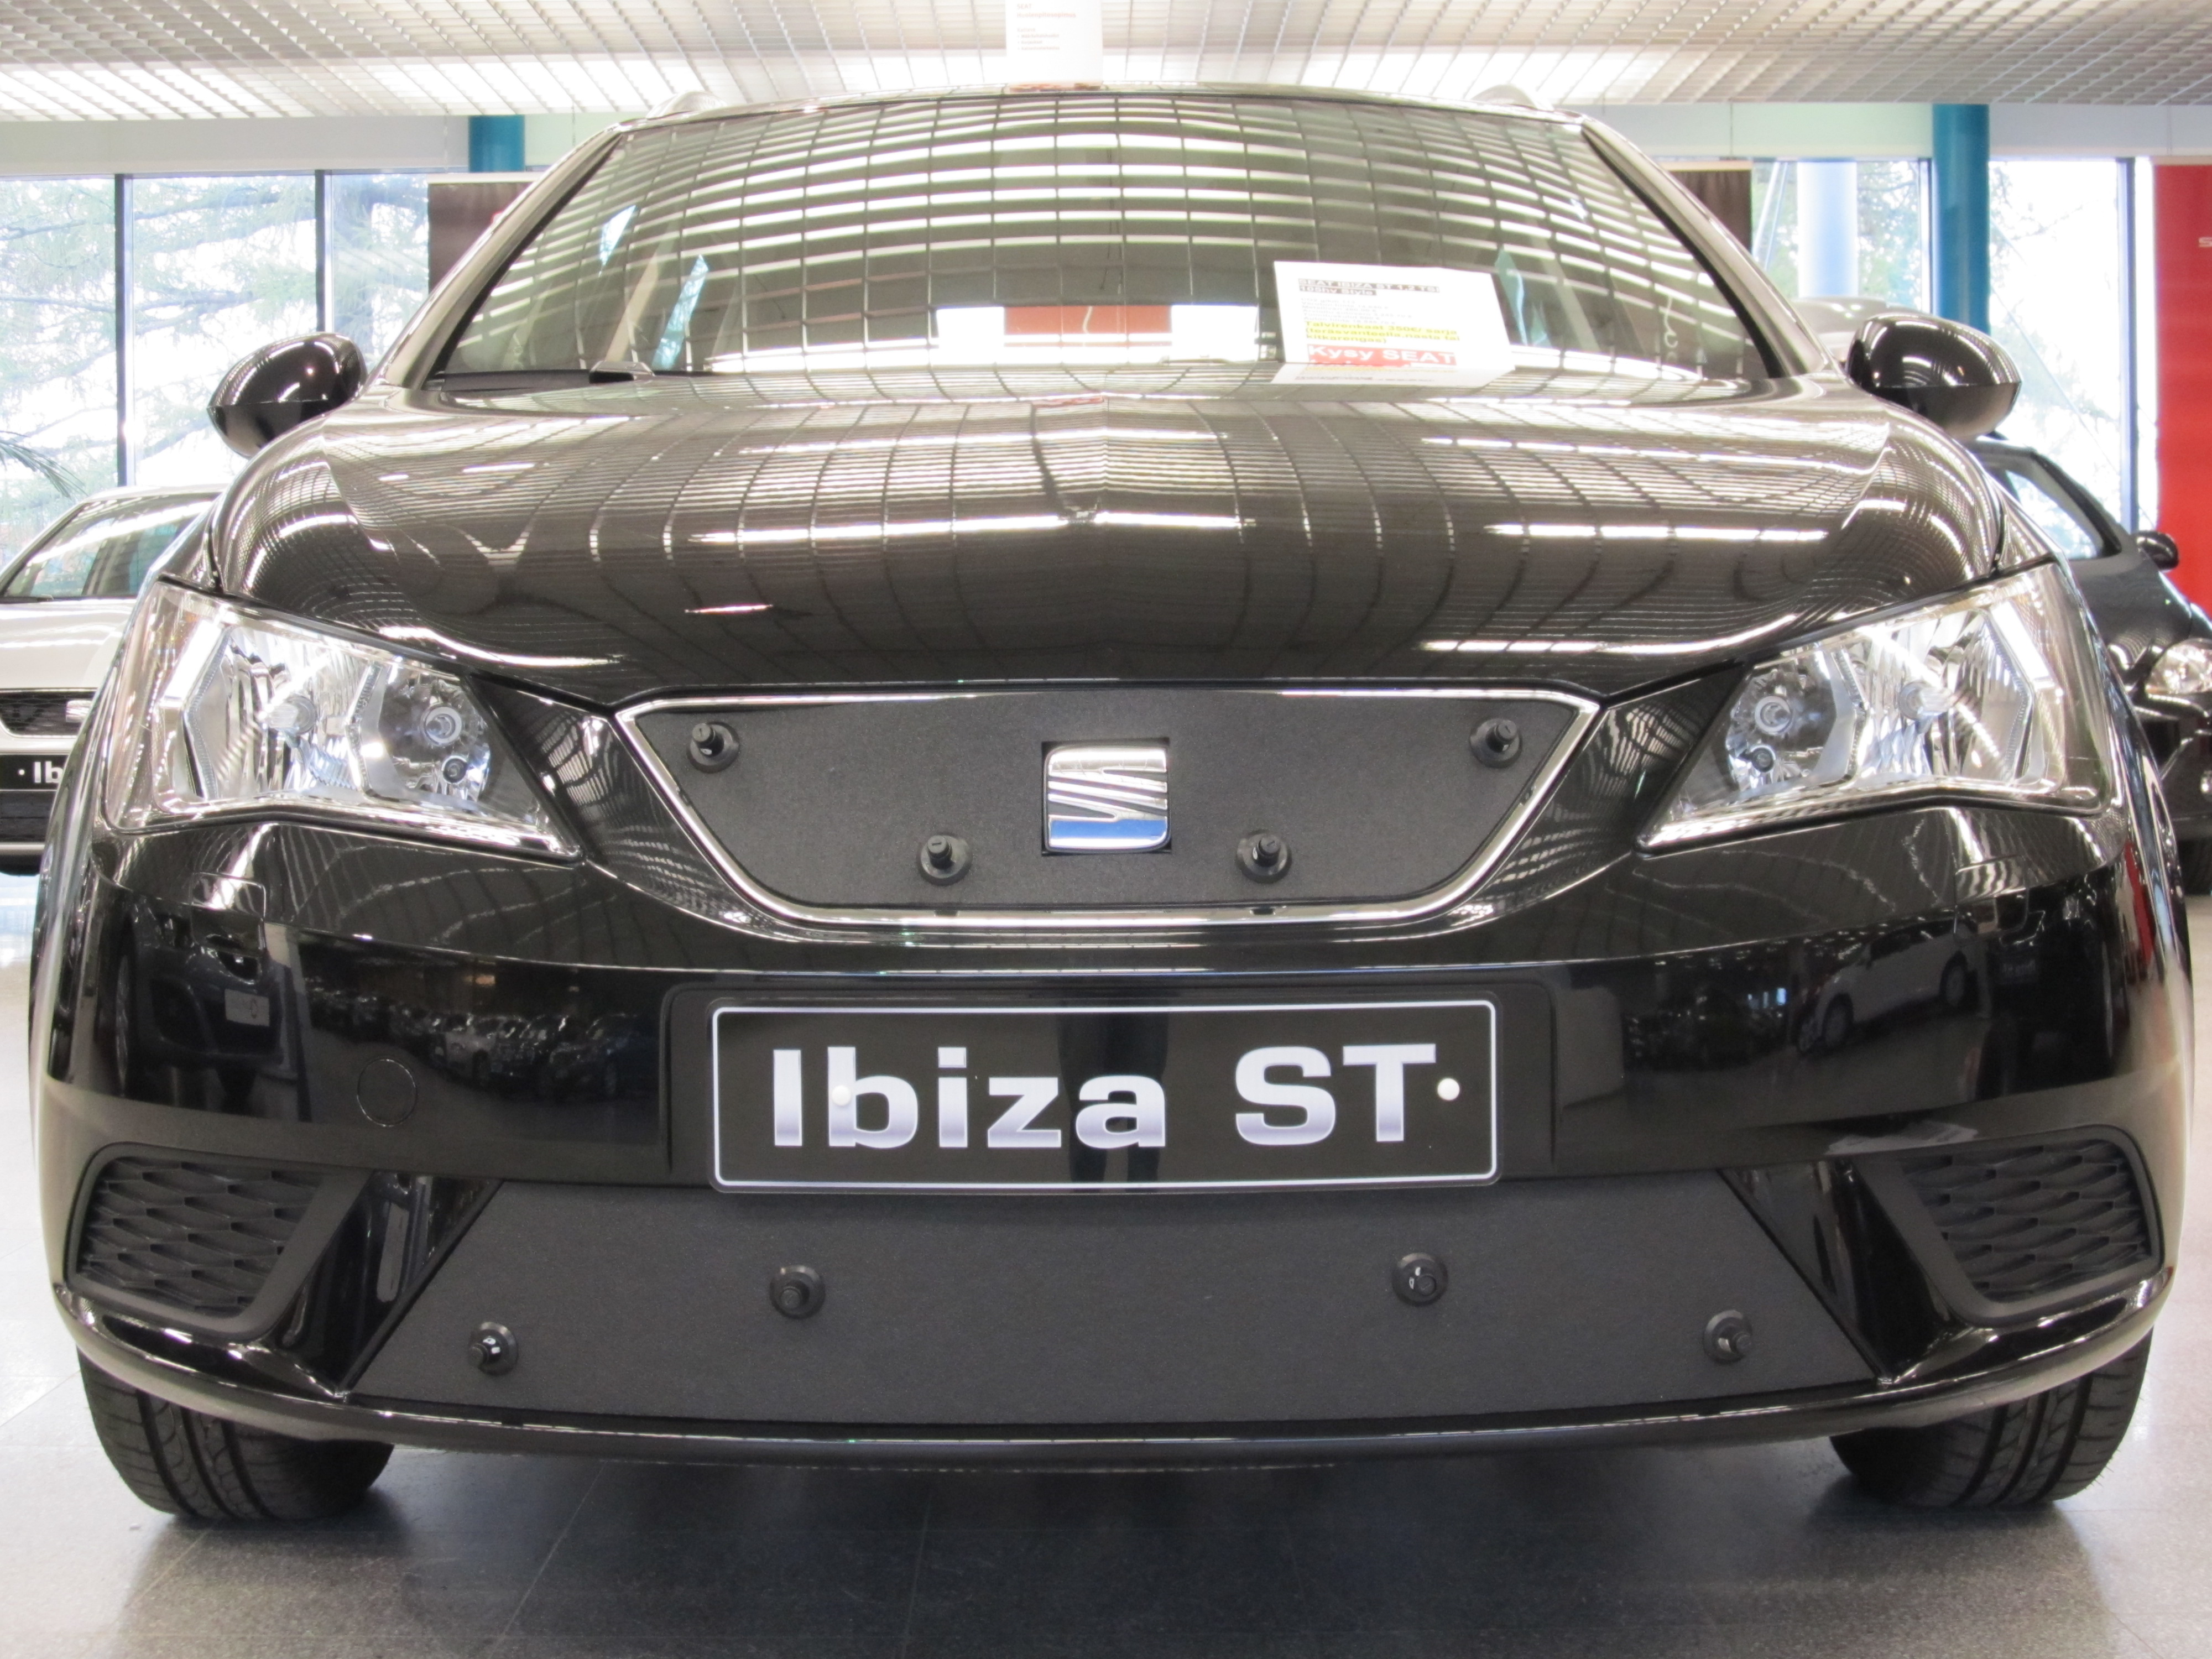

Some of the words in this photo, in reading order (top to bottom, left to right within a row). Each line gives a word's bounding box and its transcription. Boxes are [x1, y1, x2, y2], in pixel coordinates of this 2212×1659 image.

[1309, 346, 1374, 361] Kysy
[1383, 349, 1455, 363] SEAT
[773, 1046, 1165, 1149] Ibiza
[1235, 1044, 1436, 1145] ST
